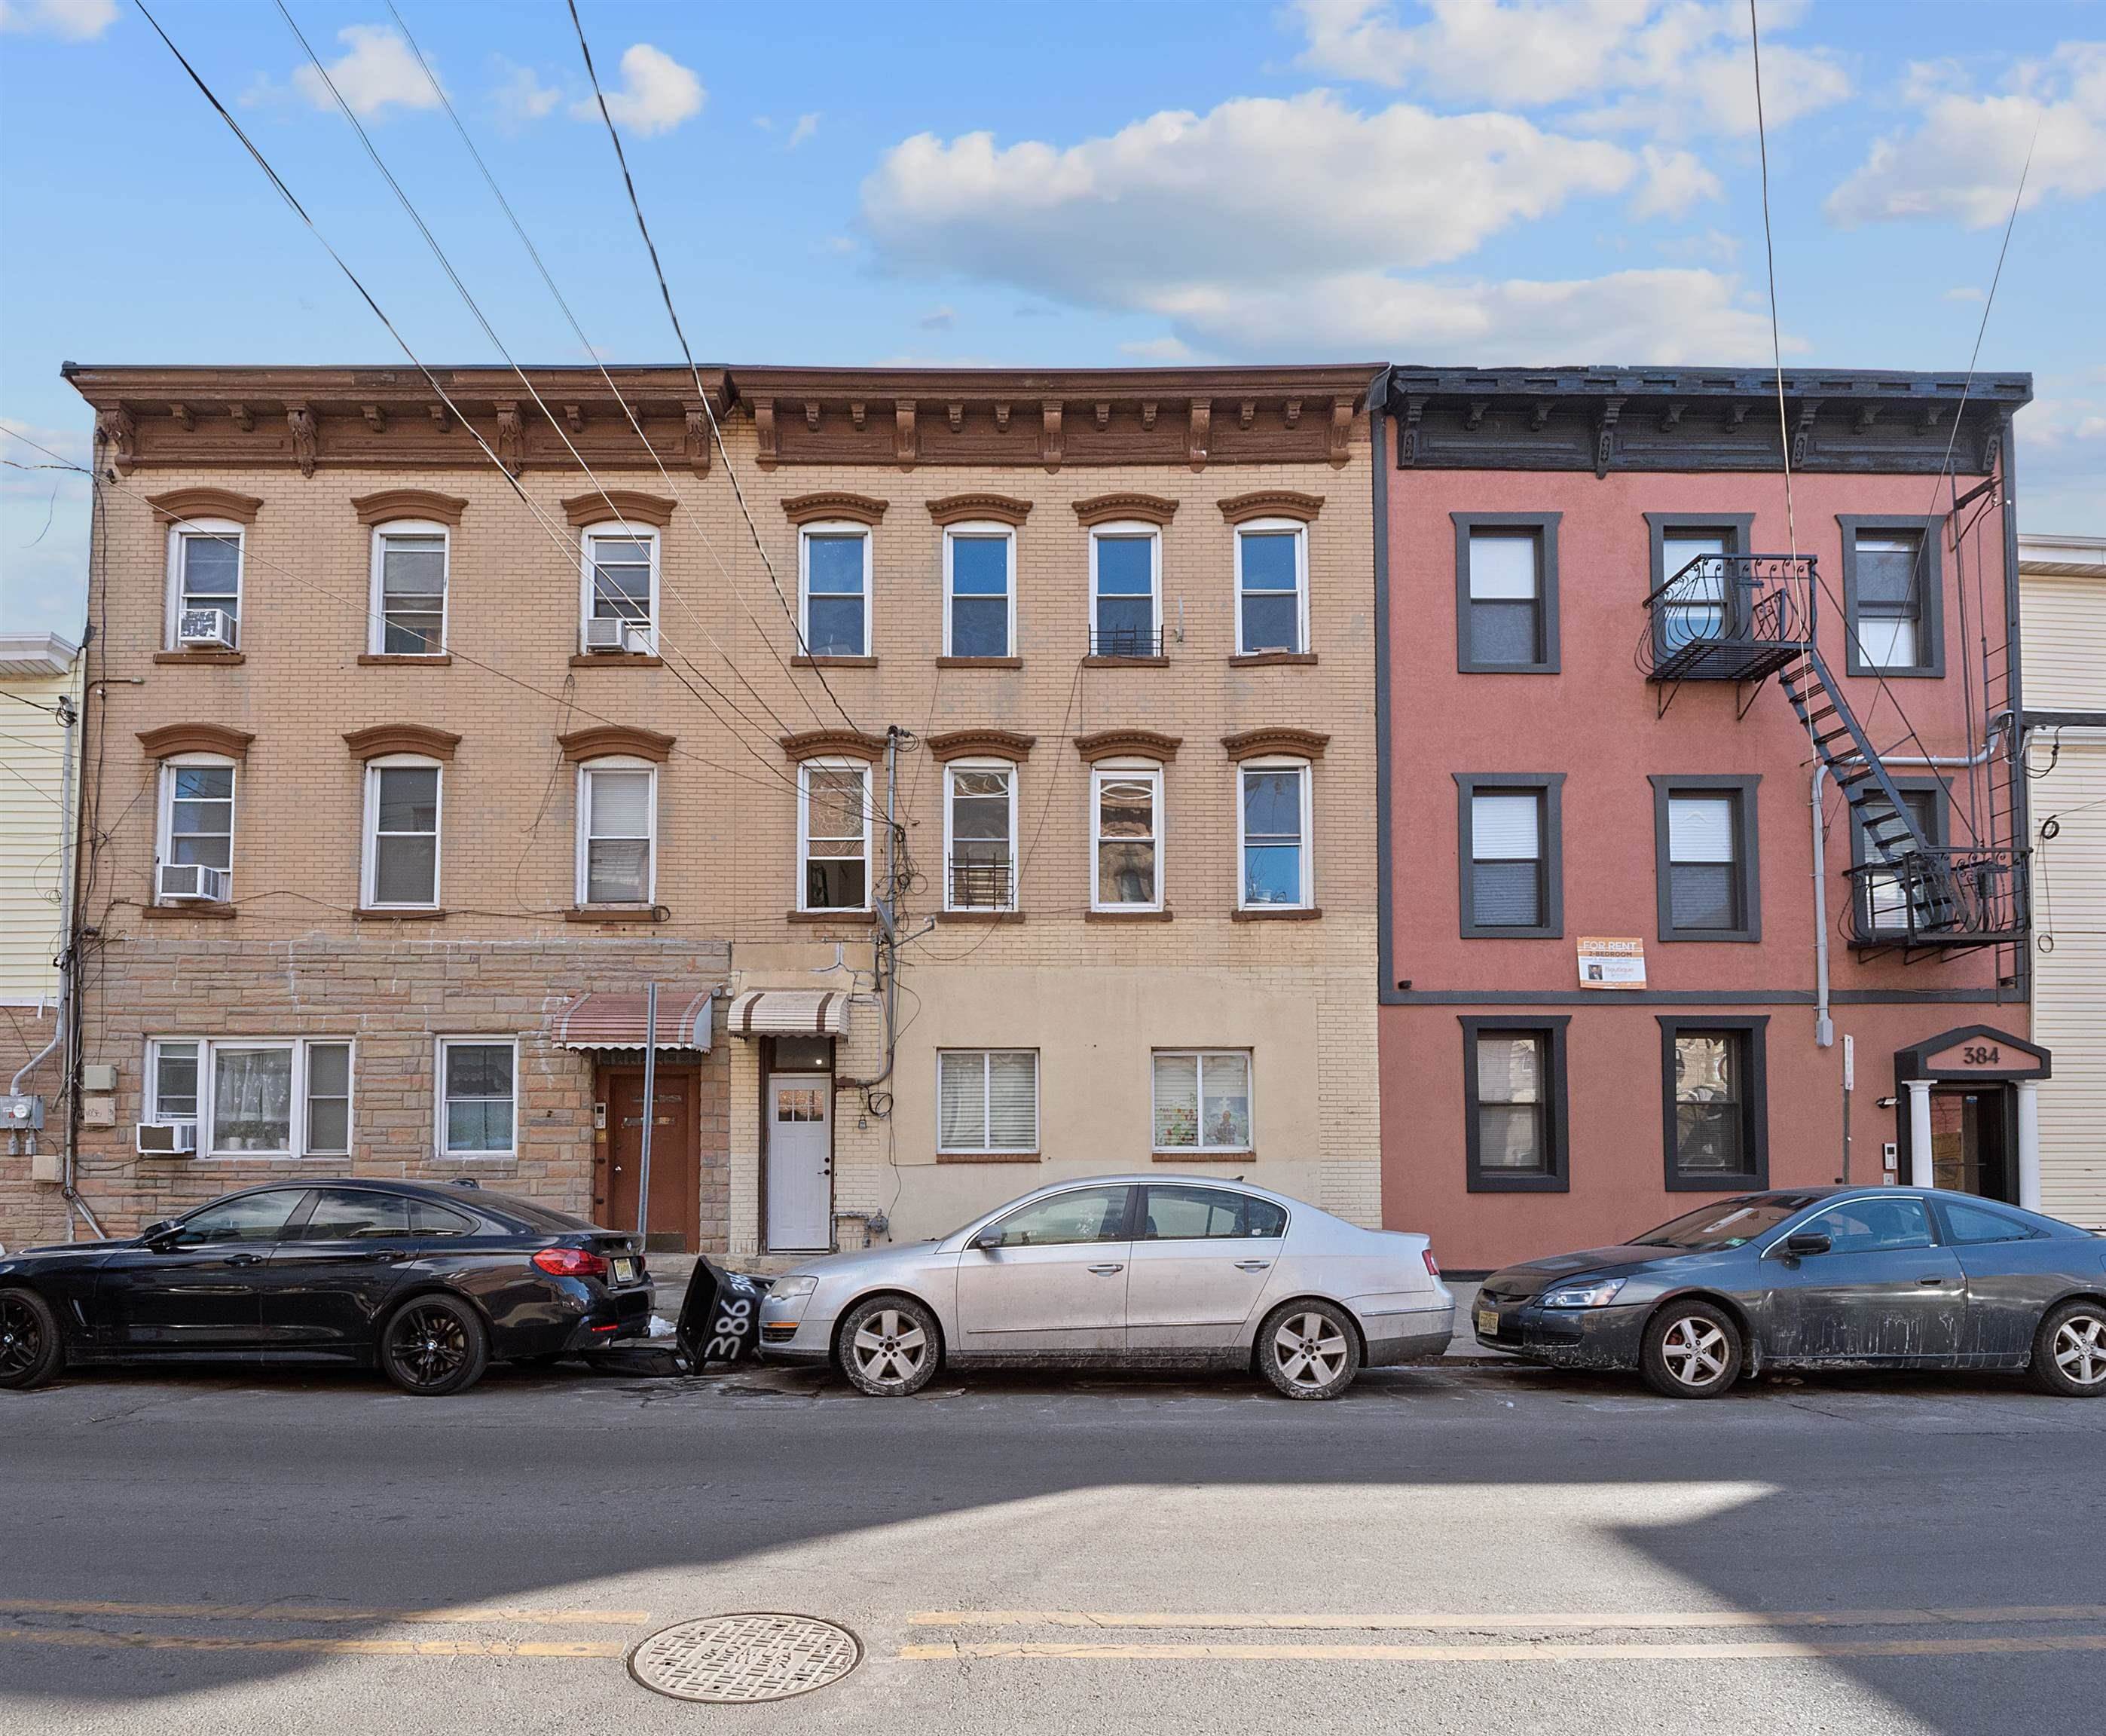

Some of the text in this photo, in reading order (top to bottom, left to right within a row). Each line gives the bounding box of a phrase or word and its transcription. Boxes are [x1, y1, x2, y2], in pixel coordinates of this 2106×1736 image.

[1583, 940, 1636, 950] FOR RENT
[1964, 1047, 2000, 1064] 384
[726, 1272, 756, 1294] 386
[704, 1299, 750, 1359] 386
[701, 1652, 789, 1669] SEWER
